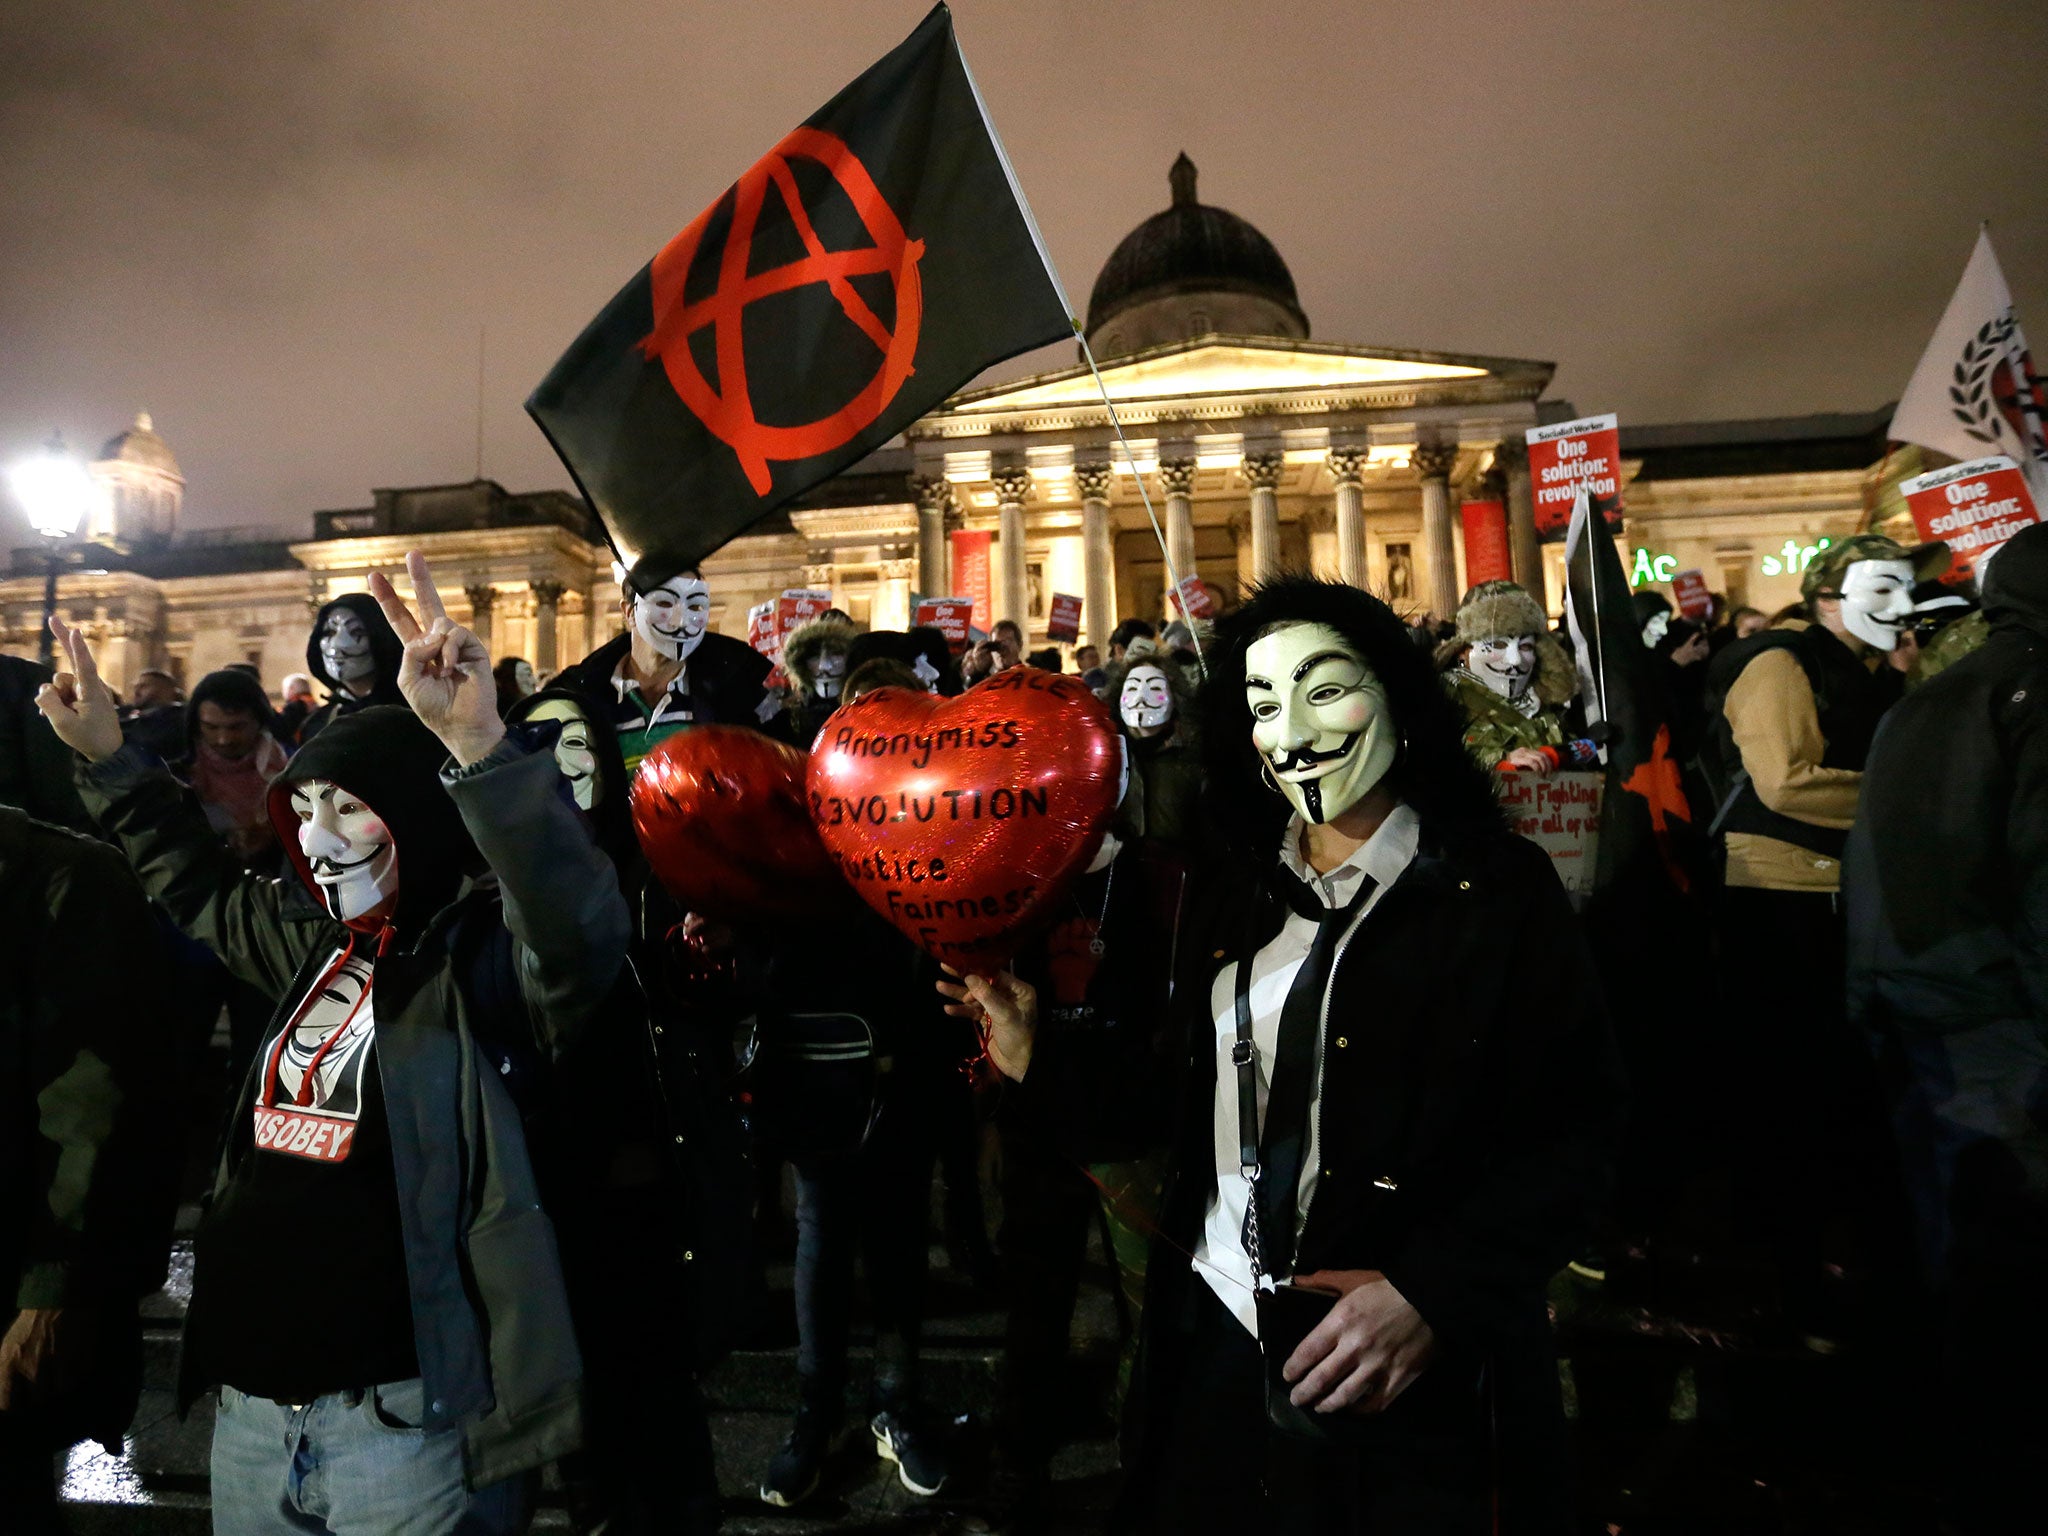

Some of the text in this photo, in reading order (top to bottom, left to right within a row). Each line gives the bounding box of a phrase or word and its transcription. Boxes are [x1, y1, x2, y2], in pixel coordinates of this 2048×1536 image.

[1538, 422, 1604, 441] Socialist Worker
[1556, 439, 1588, 459] One
[1541, 458, 1609, 483] solution:
[1945, 481, 1990, 505] One
[1928, 497, 2022, 535] solution:
[985, 672, 1074, 700] EACE
[834, 720, 1020, 769] Anonymiss
[1536, 780, 1599, 814] Fighting
